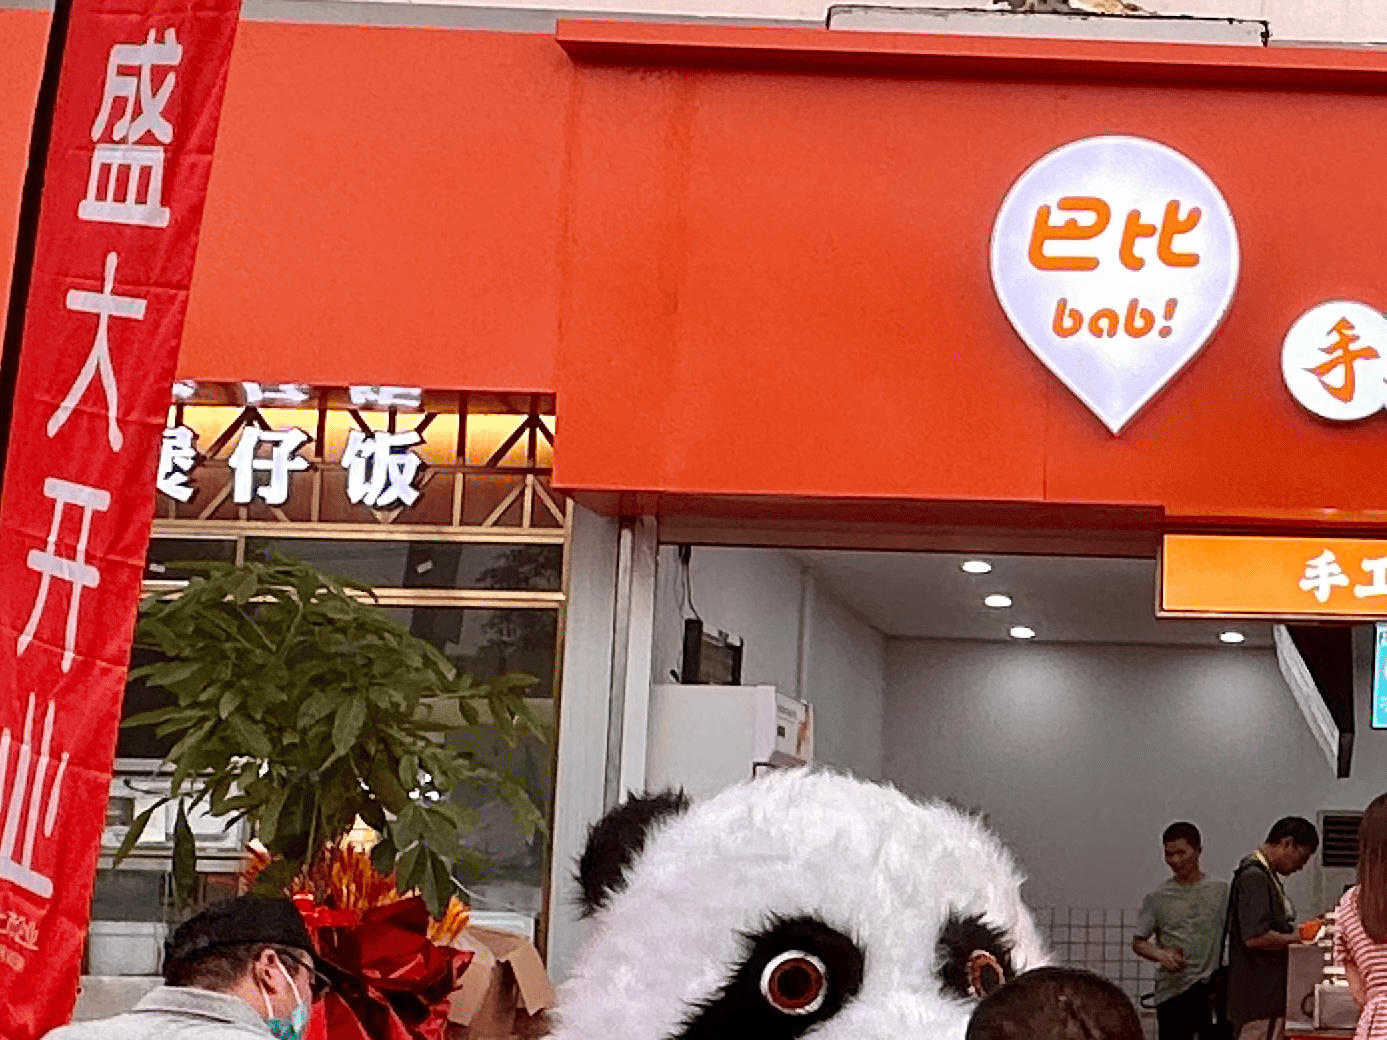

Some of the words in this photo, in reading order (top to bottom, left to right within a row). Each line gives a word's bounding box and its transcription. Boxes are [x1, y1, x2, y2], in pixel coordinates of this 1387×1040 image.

[1028, 196, 1202, 271] 巴比
[1053, 298, 1178, 338] bab!
[0, 27, 183, 899] 盛大开业
